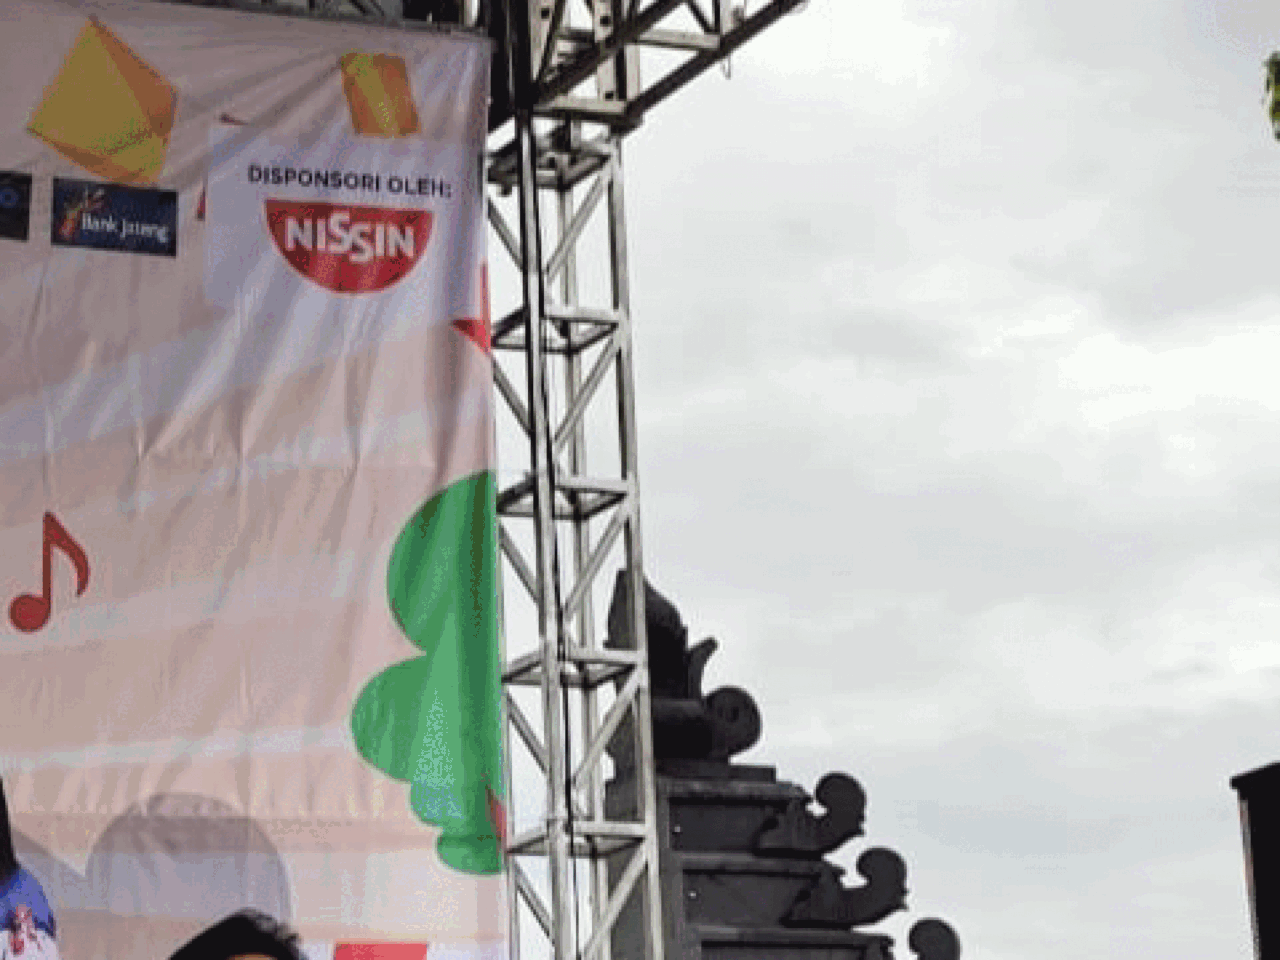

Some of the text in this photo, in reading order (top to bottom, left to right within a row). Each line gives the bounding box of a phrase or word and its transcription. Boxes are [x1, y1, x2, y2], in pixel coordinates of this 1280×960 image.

[247, 164, 453, 198] DISPONSORI OLEH:
[284, 210, 415, 264] NISSIN
